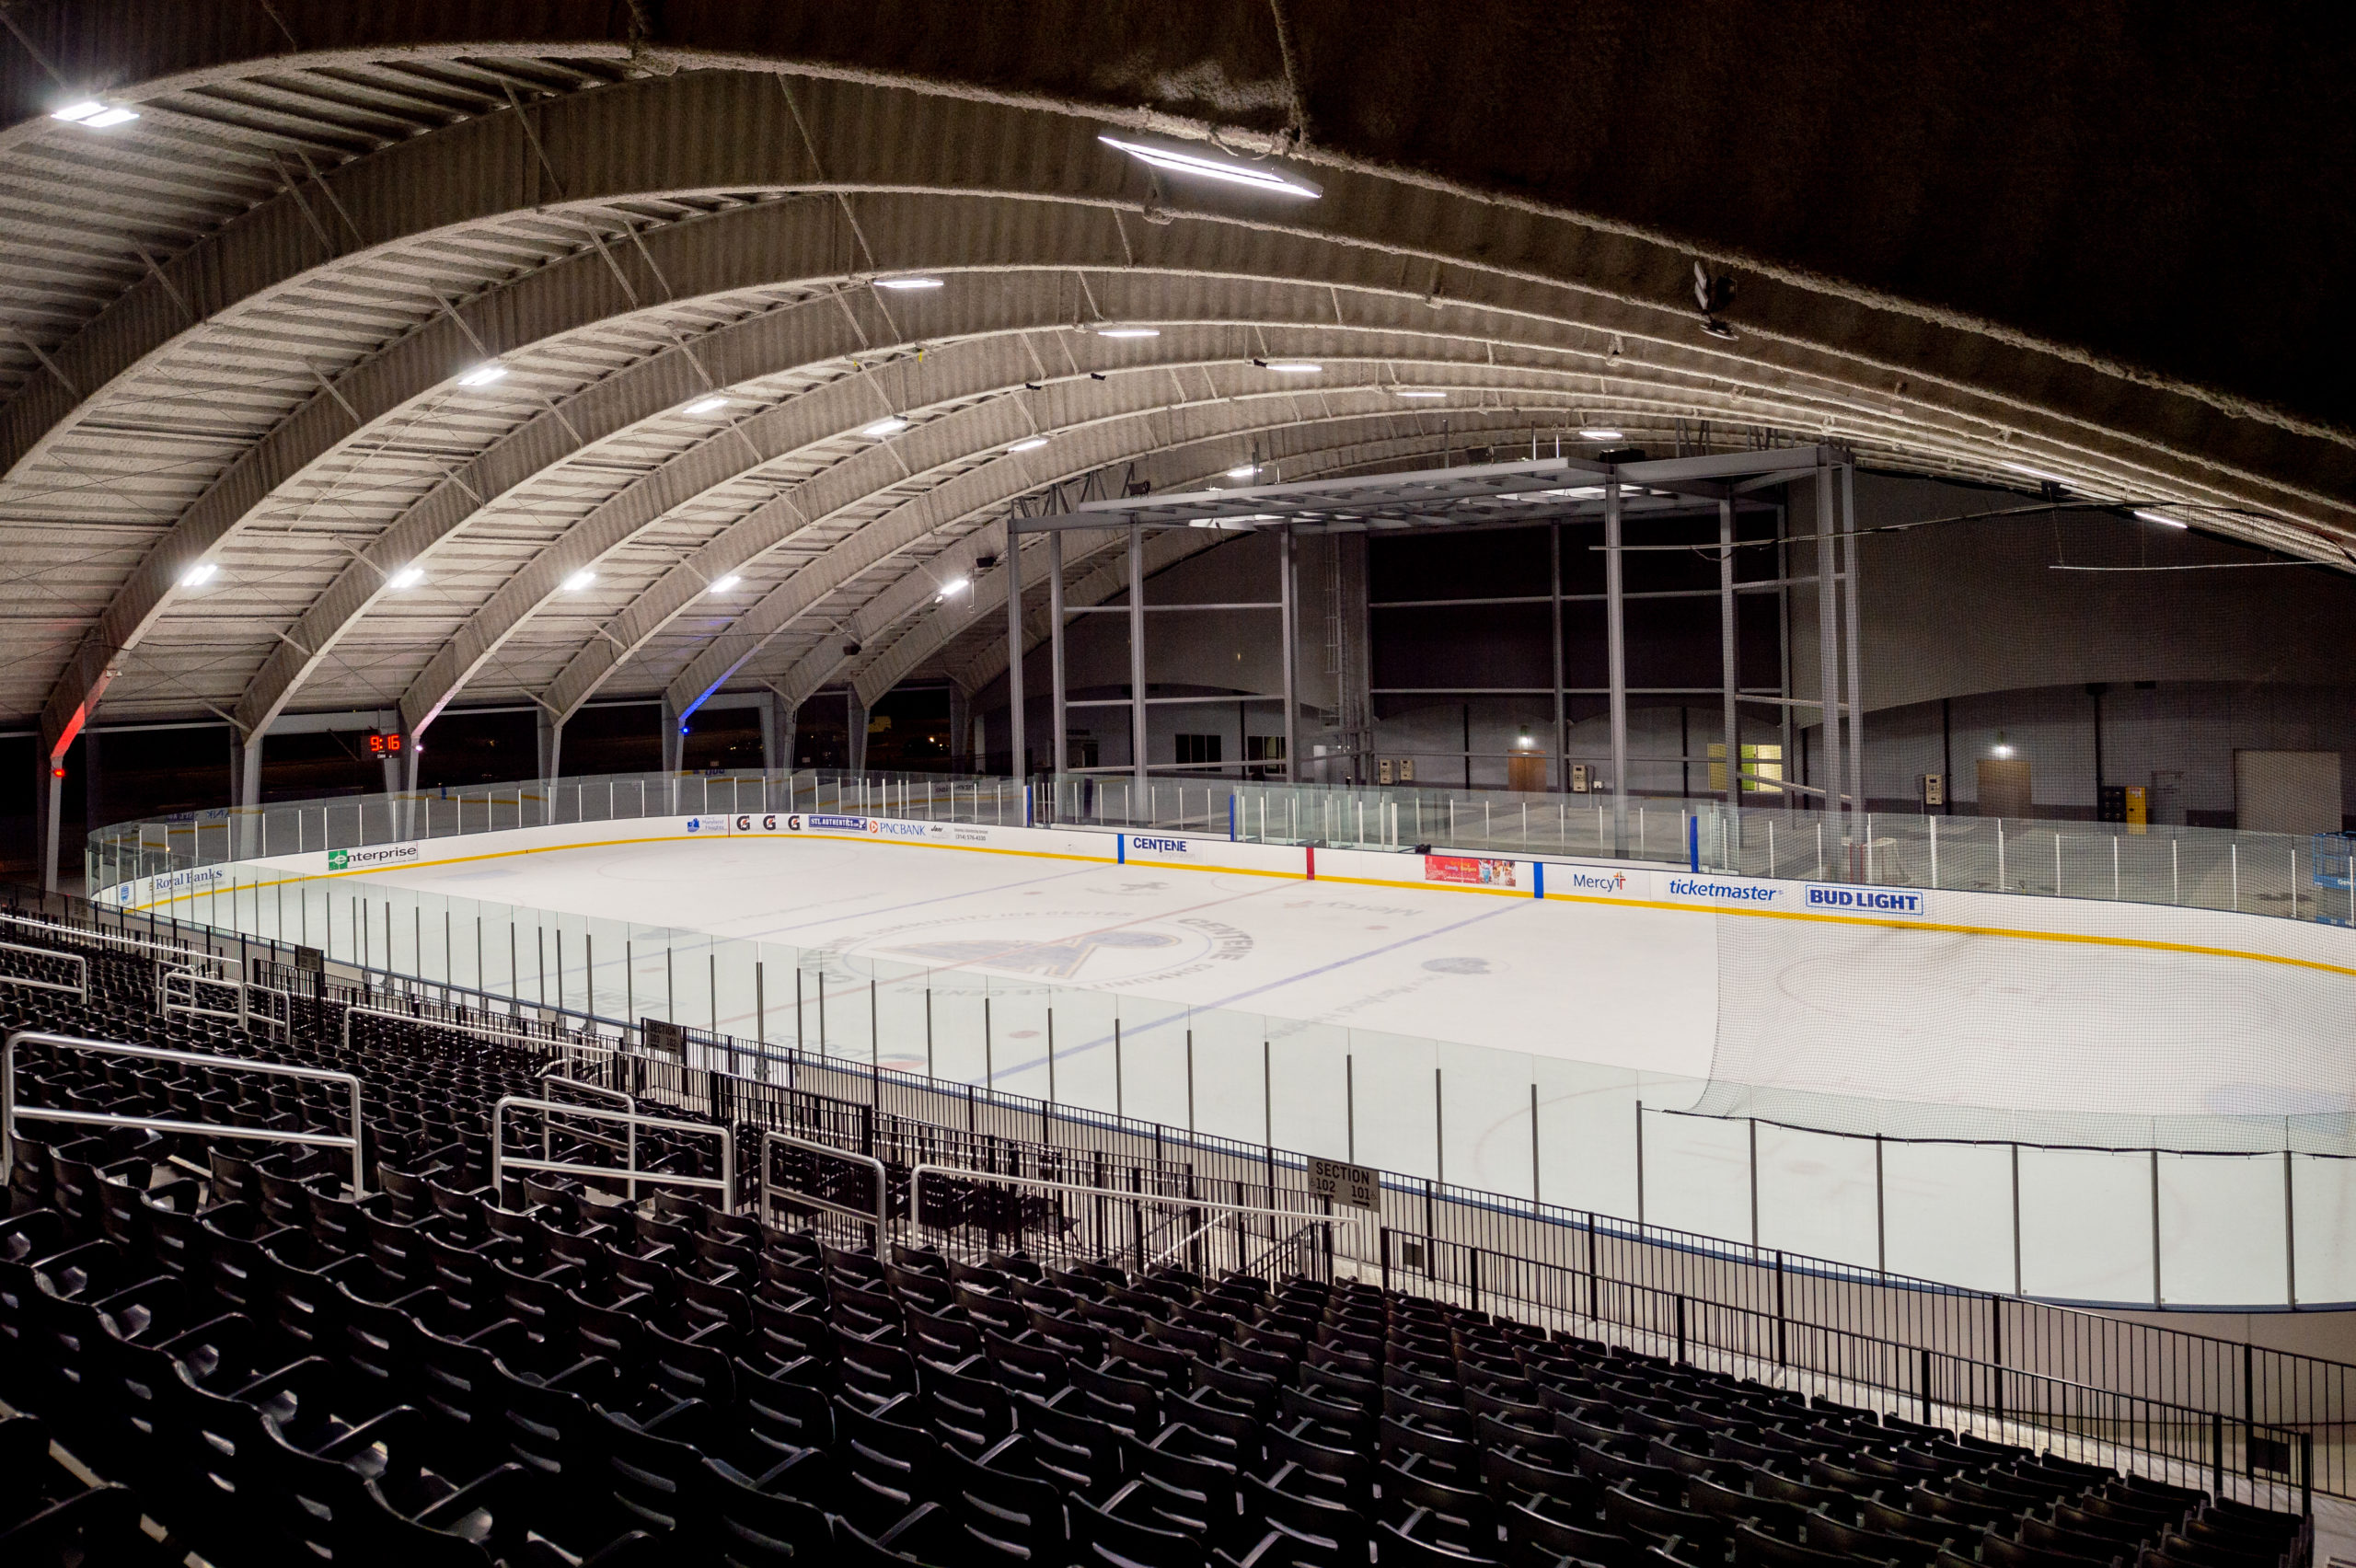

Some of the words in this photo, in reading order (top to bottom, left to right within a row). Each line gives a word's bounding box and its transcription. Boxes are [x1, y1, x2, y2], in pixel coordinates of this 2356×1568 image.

[370, 734, 399, 751] 9:16
[1133, 837, 1187, 852] CENTENE
[334, 847, 417, 864] enterprise
[156, 872, 184, 890] Royal
[1573, 873, 1613, 892] Mercy
[1669, 879, 1776, 901] ticketmaster
[1810, 889, 1854, 905] BUD
[1856, 893, 1919, 911] LIGHT
[650, 1021, 676, 1036] SECTION
[1316, 1161, 1369, 1185] SECTION
[1316, 1178, 1335, 1193] 102
[1351, 1185, 1370, 1201] 101
